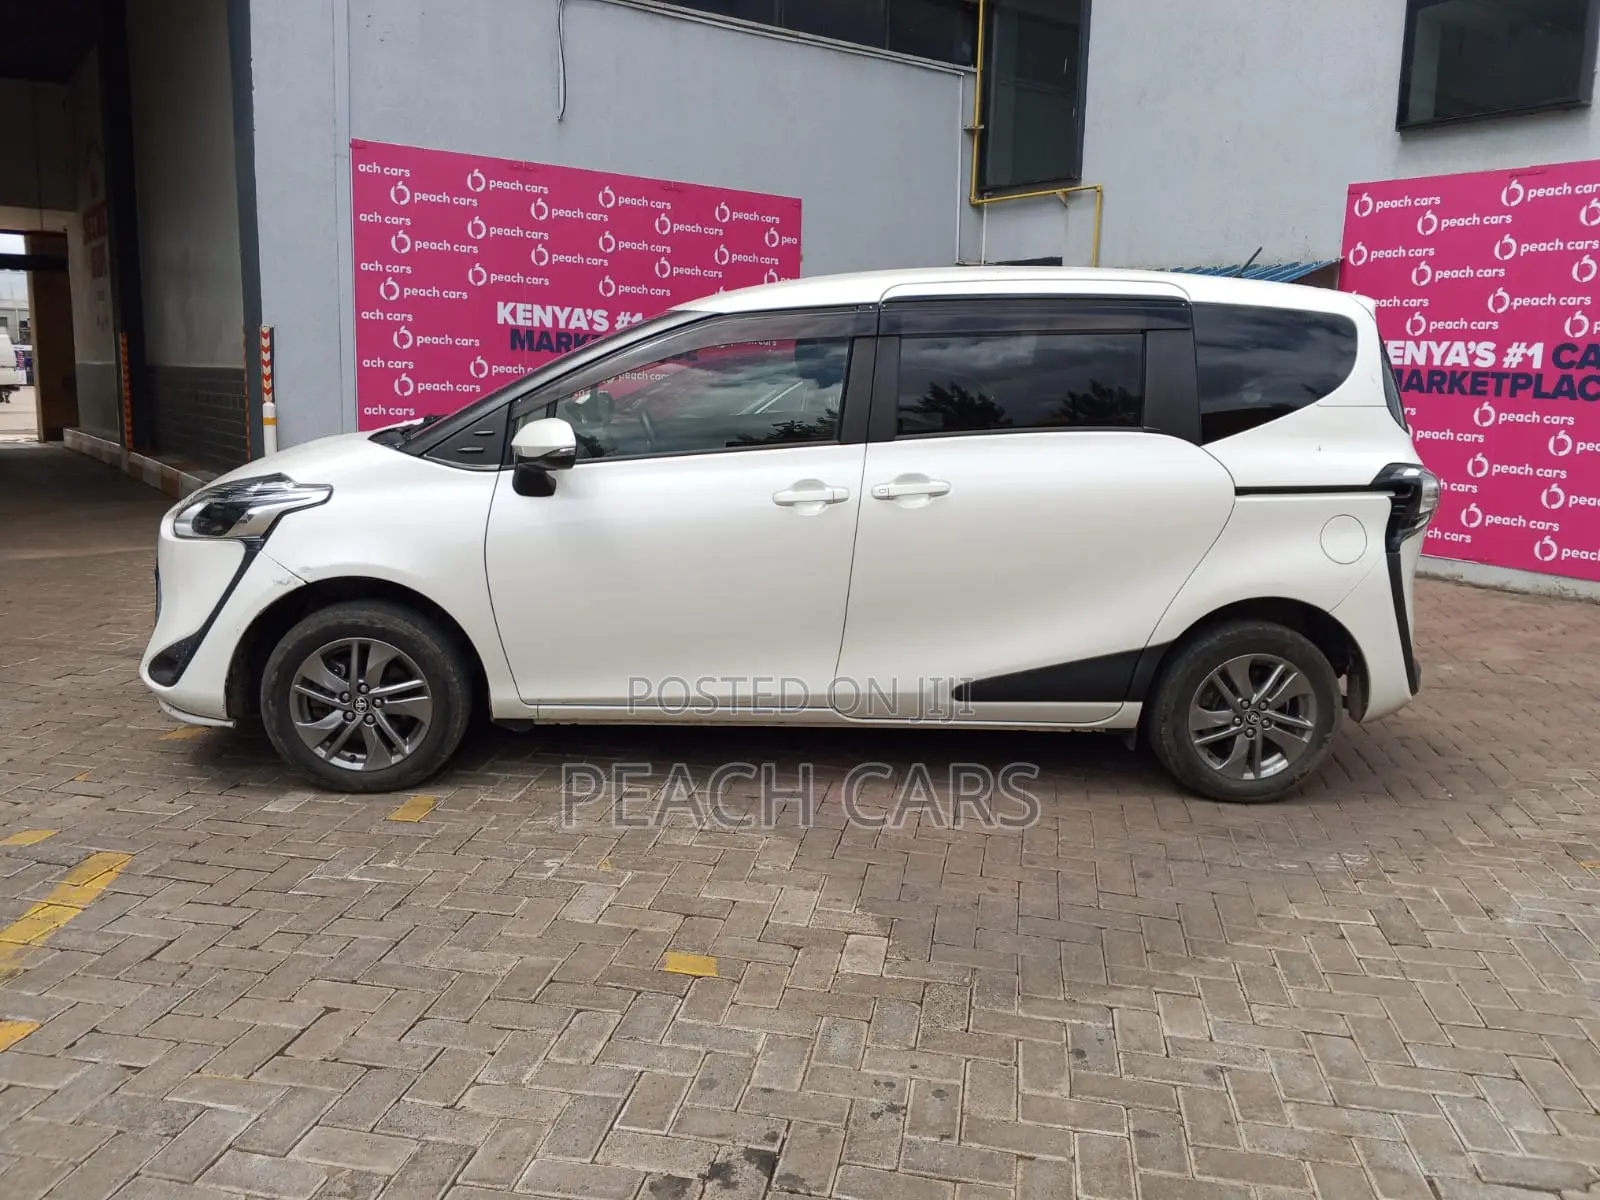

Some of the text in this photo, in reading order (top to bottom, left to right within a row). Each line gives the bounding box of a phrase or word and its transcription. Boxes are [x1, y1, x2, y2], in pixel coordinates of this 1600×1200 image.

[384, 167, 410, 177] cars
[490, 180, 548, 194] peach cars
[1528, 183, 1600, 201] peach car
[414, 192, 477, 206] peach cars
[619, 197, 671, 209] peach cars
[1376, 196, 1440, 212] peach cars
[385, 216, 411, 225] cars
[552, 208, 608, 221] peach cars
[733, 212, 759, 221] peach
[1441, 214, 1512, 231] peach cars
[490, 227, 549, 240] peach cars
[673, 224, 723, 235] peach cars
[415, 240, 478, 253] peach cars
[619, 241, 671, 253] peach cars
[1520, 239, 1599, 256] peach cars
[552, 254, 608, 266] peach cars
[732, 254, 779, 265] peach cars
[1371, 246, 1434, 262] peach cars
[386, 265, 412, 273] cars
[673, 266, 722, 278] peach cars
[1435, 266, 1505, 282] peach cars
[491, 273, 549, 285] peach cars
[404, 287, 467, 299] peach cars
[619, 285, 670, 296] peach cars
[1374, 296, 1400, 308] each
[1512, 294, 1591, 309] peach cars
[387, 313, 412, 321] cars
[497, 301, 609, 332] KENYA'S
[1430, 318, 1498, 332] peach cars
[417, 335, 479, 346] peach cars
[1386, 341, 1496, 368] ENYA'S
[1503, 342, 1544, 369] #1
[492, 364, 524, 376] peach
[418, 381, 480, 393] peach cars
[1398, 369, 1600, 402] ARKETPLAC
[1499, 411, 1574, 425] peach cars
[1417, 429, 1484, 442] peach cars
[1492, 464, 1566, 479] peach cars
[1450, 483, 1477, 493] cars
[1485, 515, 1559, 531] peach cars
[1444, 532, 1471, 543] cars
[1562, 548, 1600, 561] peac
